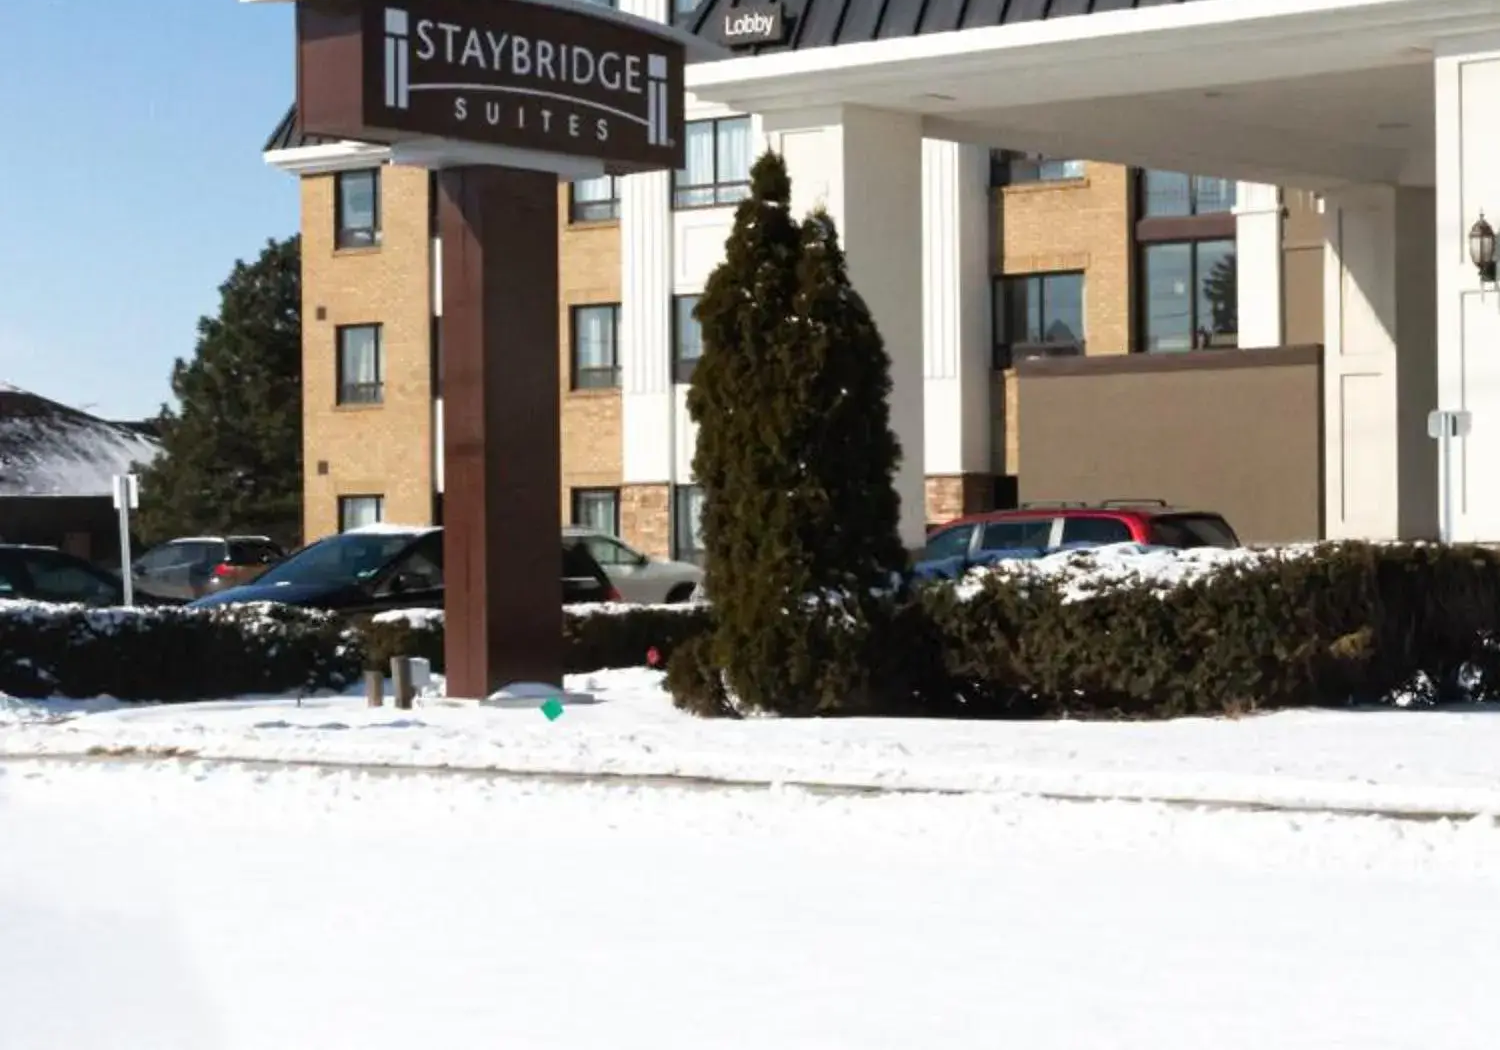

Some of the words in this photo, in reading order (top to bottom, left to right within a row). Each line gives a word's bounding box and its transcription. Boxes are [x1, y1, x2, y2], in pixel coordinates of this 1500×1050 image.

[725, 13, 774, 36] Lobby
[416, 19, 642, 94] STAYBRIDGE
[455, 97, 608, 141] SUITES
